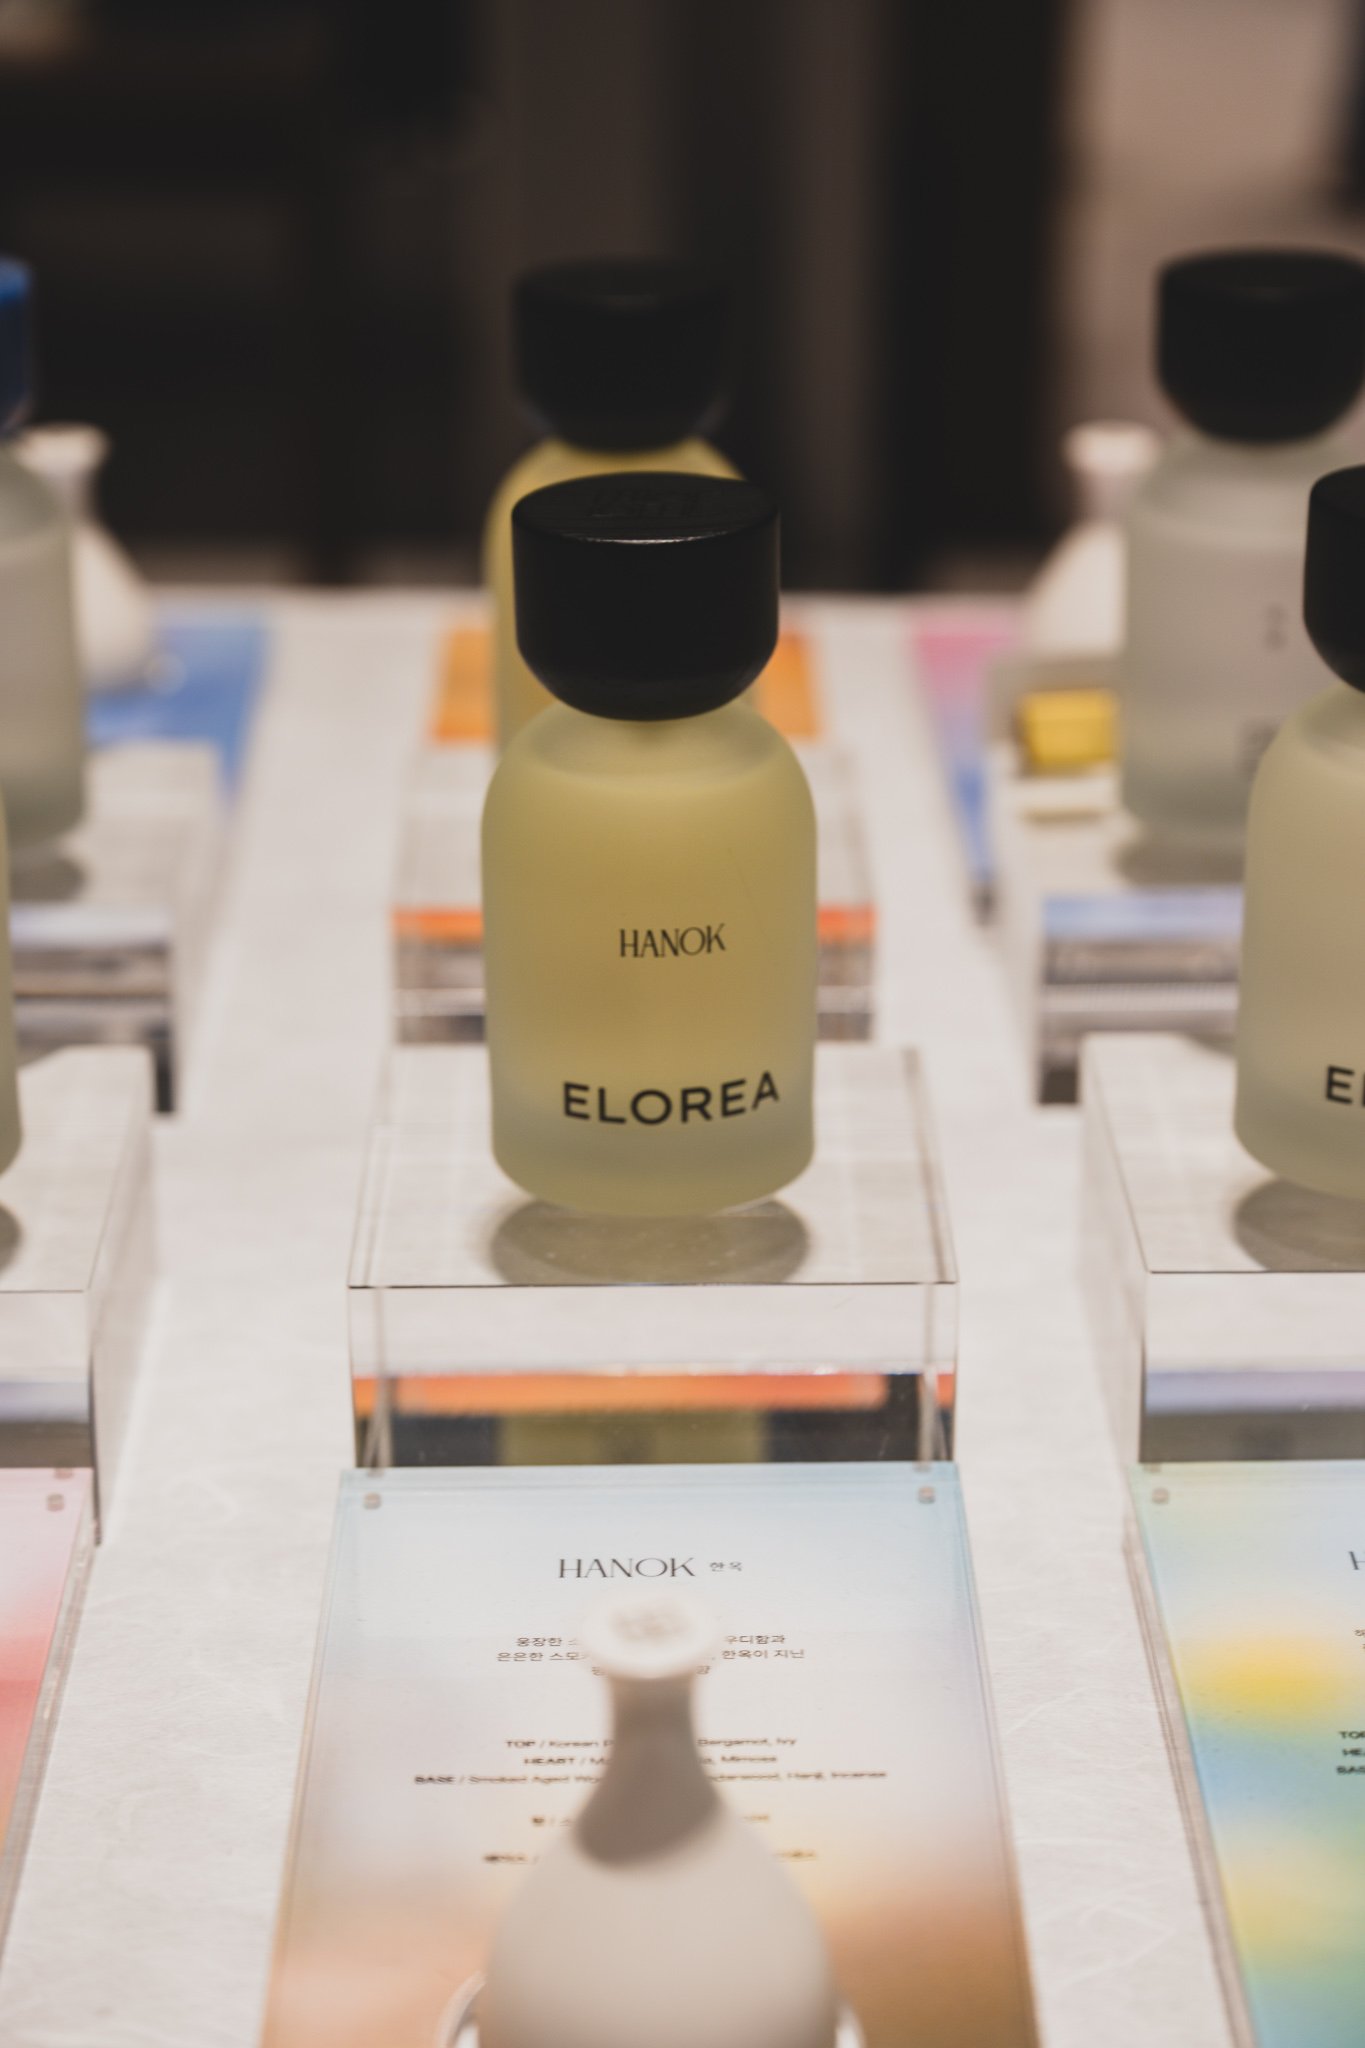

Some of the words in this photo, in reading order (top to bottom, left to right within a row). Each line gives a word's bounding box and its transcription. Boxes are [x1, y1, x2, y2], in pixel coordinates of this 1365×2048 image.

[618, 922, 727, 959] HANOK
[1325, 1064, 1365, 1108] E
[563, 1070, 780, 1126] ELOREA
[557, 1556, 697, 1579] HANOK
[709, 1561, 743, 1573] 한옥
[496, 1651, 544, 1662] 은은한
[549, 1651, 588, 1661] 스모
[721, 1649, 769, 1660] 한옥이
[774, 1648, 806, 1659] 지닌
[505, 1740, 536, 1749] TOP
[523, 1757, 575, 1766] HEART
[414, 1775, 456, 1785] BASE
